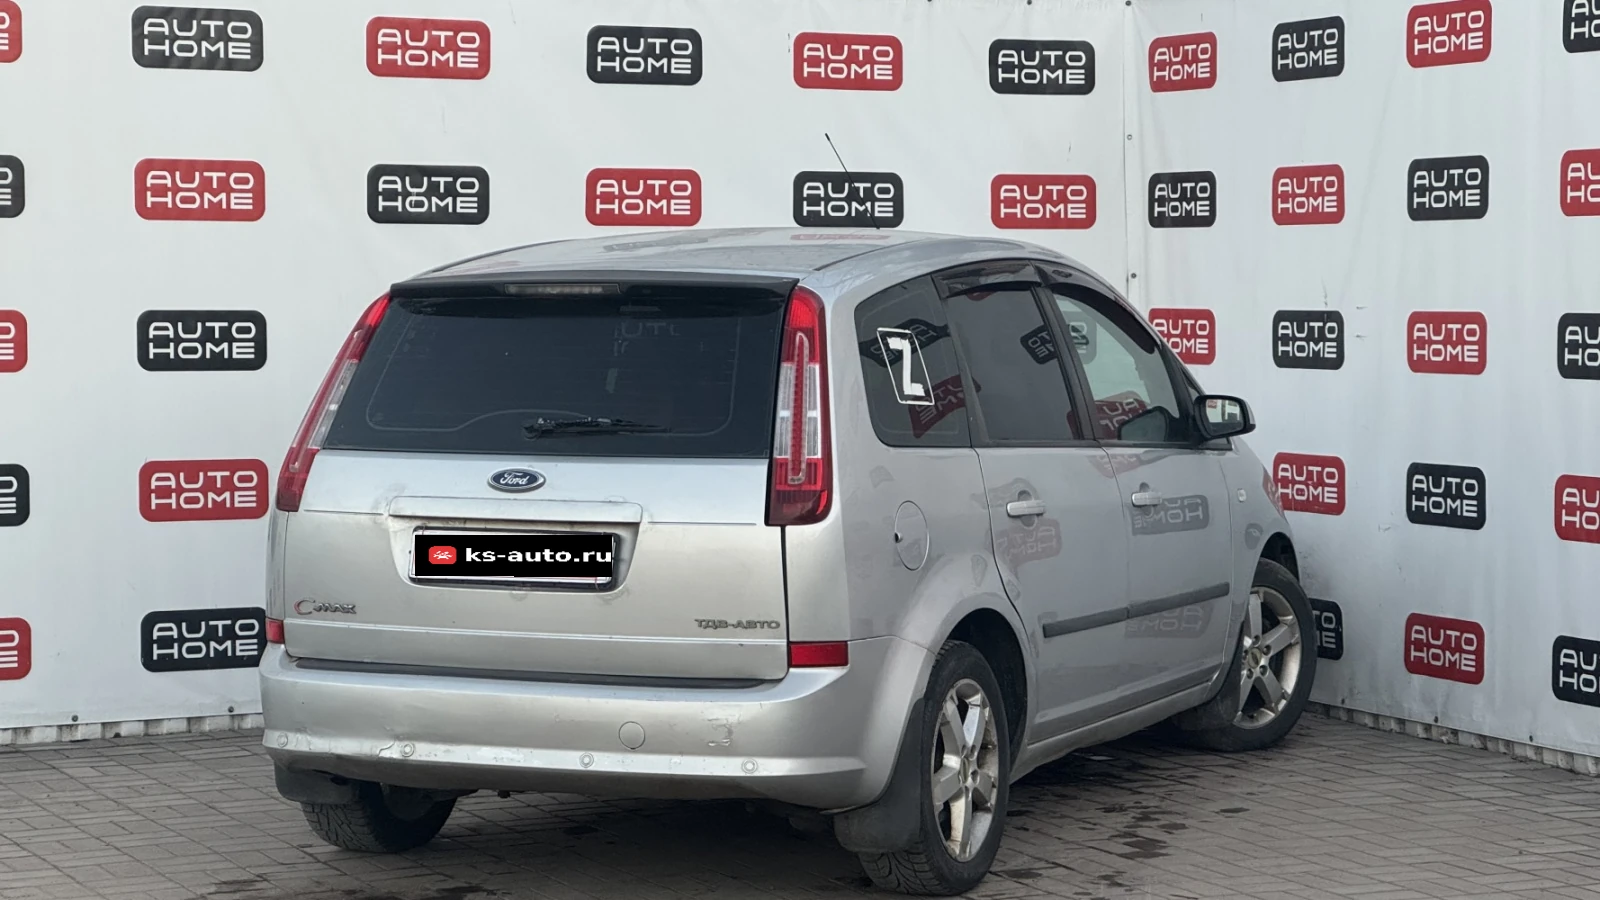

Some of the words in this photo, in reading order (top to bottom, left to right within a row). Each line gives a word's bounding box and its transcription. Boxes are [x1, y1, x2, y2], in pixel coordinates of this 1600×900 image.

[143, 17, 253, 39] AUTO
[1414, 10, 1485, 35] AUTO
[377, 28, 481, 49] AUTO
[597, 36, 693, 55] AUTO
[1277, 28, 1339, 51] AUTO
[1414, 31, 1484, 56] HOME
[143, 38, 251, 60] HOME
[377, 48, 479, 68] HOME
[803, 43, 894, 62] AUTO
[997, 49, 1086, 67] AUTO
[1154, 42, 1212, 64] AUTO
[1277, 47, 1338, 70] HOME
[596, 55, 692, 75] HOME
[803, 61, 893, 80] HOME
[1153, 61, 1211, 82] HOME
[997, 67, 1085, 85] HOME
[146, 170, 255, 190] AUTO
[1413, 167, 1482, 188] AUTO
[1567, 162, 1600, 182] AU
[378, 175, 480, 194] AUTO
[596, 179, 692, 196] AUTO
[803, 182, 895, 199] AUTO
[1000, 184, 1088, 201] AUTO
[1154, 181, 1211, 199] AUTO
[1277, 175, 1338, 195] AUTO
[1566, 184, 1600, 203] HO
[146, 190, 253, 210] HOME
[378, 195, 478, 213] HOME
[595, 198, 691, 215] HOME
[802, 200, 894, 217] HOME
[1154, 200, 1210, 217] HOME
[1277, 195, 1338, 214] HOME
[1413, 188, 1481, 209] HOME
[1000, 202, 1087, 219] HOME
[148, 321, 256, 339] AUTO
[1151, 318, 1211, 337] AUTO
[1278, 321, 1338, 339] AUTO
[1413, 323, 1480, 342] AUTO
[1564, 325, 1600, 345] AU
[148, 341, 255, 359] HOME
[1164, 336, 1210, 355] OME
[1278, 340, 1337, 358] HOME
[1413, 343, 1479, 363] HOME
[1564, 347, 1600, 367] HO
[150, 470, 258, 490] AUTO
[500, 472, 530, 485] Ford
[1278, 463, 1339, 484] AUTO
[1277, 482, 1339, 505] HOME
[1412, 474, 1479, 497] AUTO
[150, 490, 257, 510] HOME
[1411, 494, 1478, 518] HOME
[1562, 487, 1600, 508] AU
[1561, 508, 1600, 530] HO
[152, 618, 260, 640] AUTO
[694, 618, 781, 630] ТДВ-АВТО
[1411, 625, 1478, 651] AUTO
[152, 638, 258, 661] HOME
[1410, 644, 1476, 672] HOME
[1559, 648, 1600, 671] AU
[1559, 669, 1600, 693] HO
